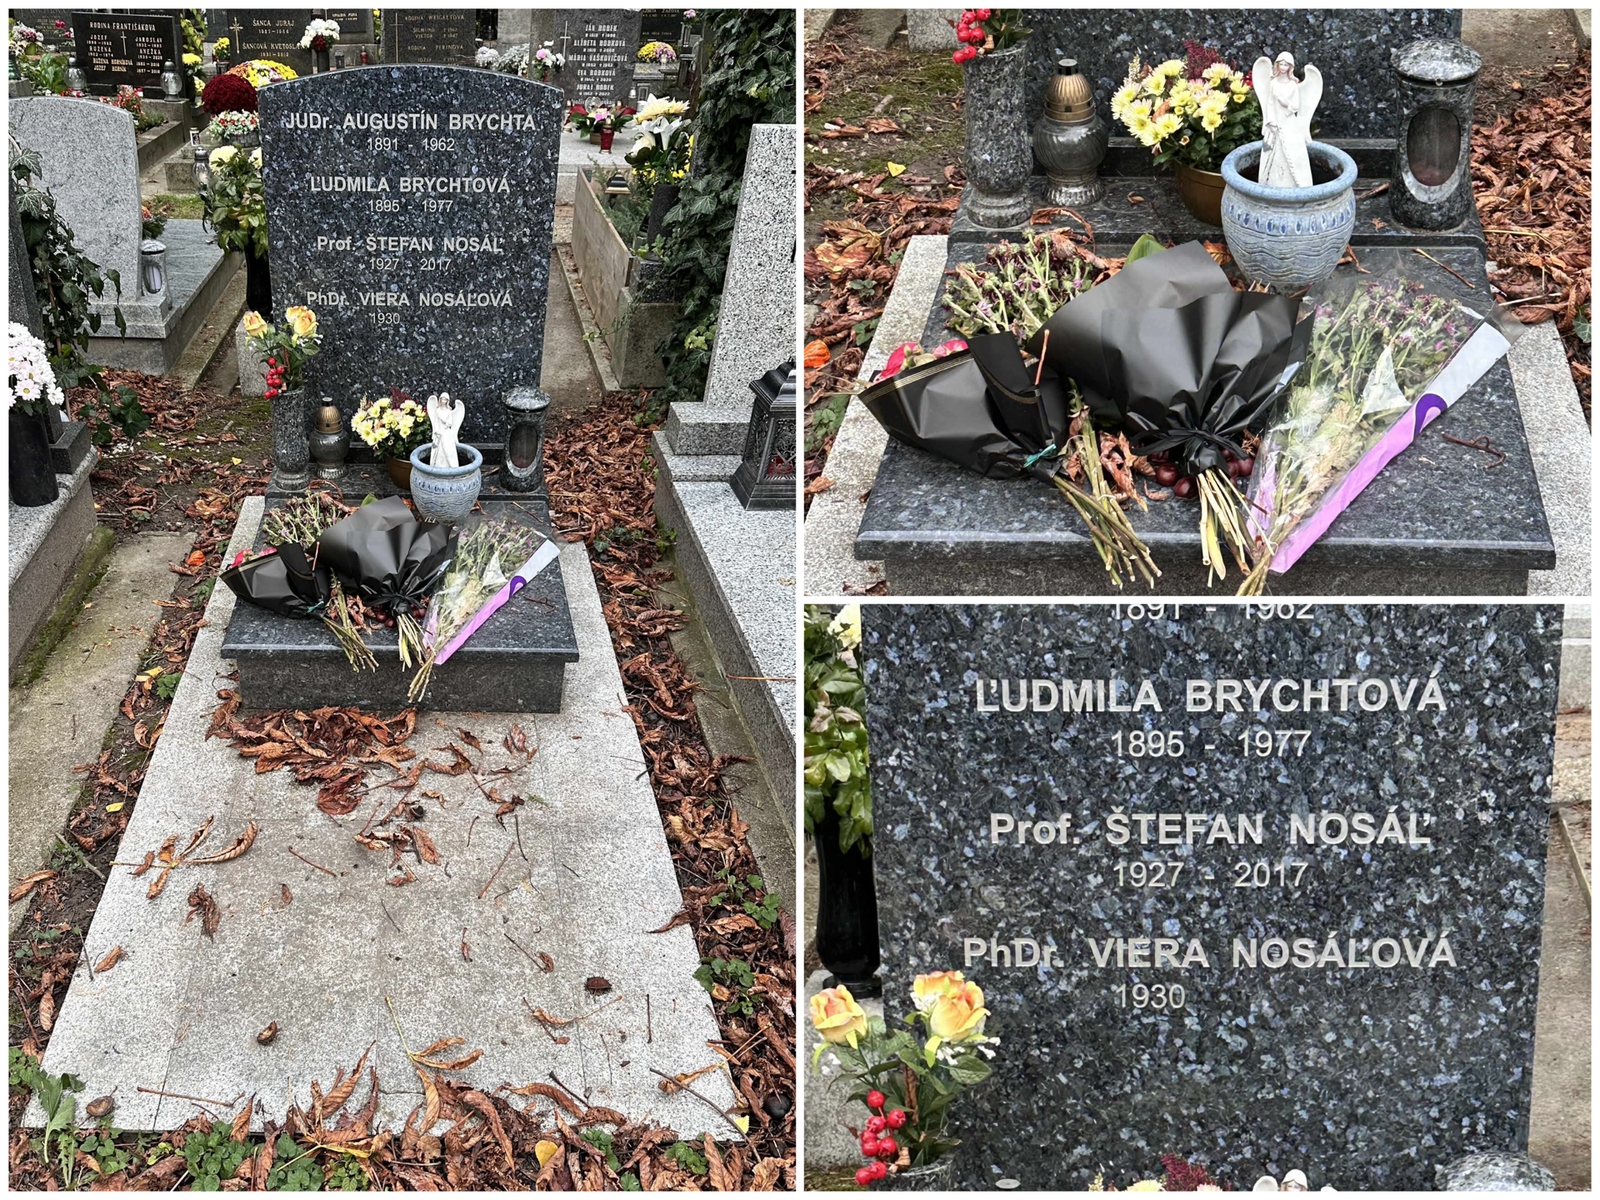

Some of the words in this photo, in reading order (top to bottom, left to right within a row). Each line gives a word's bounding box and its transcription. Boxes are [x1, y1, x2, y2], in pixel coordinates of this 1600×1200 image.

[285, 113, 332, 129] JUDr.
[343, 110, 438, 130] AUGUSTÍN
[449, 114, 536, 131] BRYCHTA
[367, 138, 398, 150] 1891
[422, 138, 455, 151] 1962
[311, 176, 390, 192] ĽUDMILA
[400, 174, 511, 193] BRYCHTOVÁ
[368, 200, 400, 212] 1895
[421, 200, 453, 212] 1977
[317, 236, 355, 251] Prof.
[366, 233, 433, 251] ŠTEFAN
[443, 233, 504, 252] NOSÁĽ
[370, 258, 399, 270] 1927
[420, 258, 451, 270] 2017
[307, 292, 349, 306] PhDr.
[360, 292, 410, 307] VIERA
[371, 312, 400, 324] 1930
[1113, 603, 1181, 620] 1891
[1246, 603, 1315, 620] 1962
[976, 678, 1162, 712] ĽUDMILA
[1186, 673, 1447, 712] BRYCHTOVÁ
[1111, 730, 1185, 758] 1895
[1238, 730, 1312, 758] 1977
[990, 813, 1081, 846] Prof.
[1106, 807, 1264, 846] ŠTEFAN
[1290, 806, 1431, 845] NOSÁĽ
[1113, 862, 1183, 888] 1927
[1234, 862, 1308, 888] 2017
[963, 937, 1064, 968] PhDr.
[1088, 938, 1210, 968] VIERA
[1115, 985, 1186, 1010] 1930
